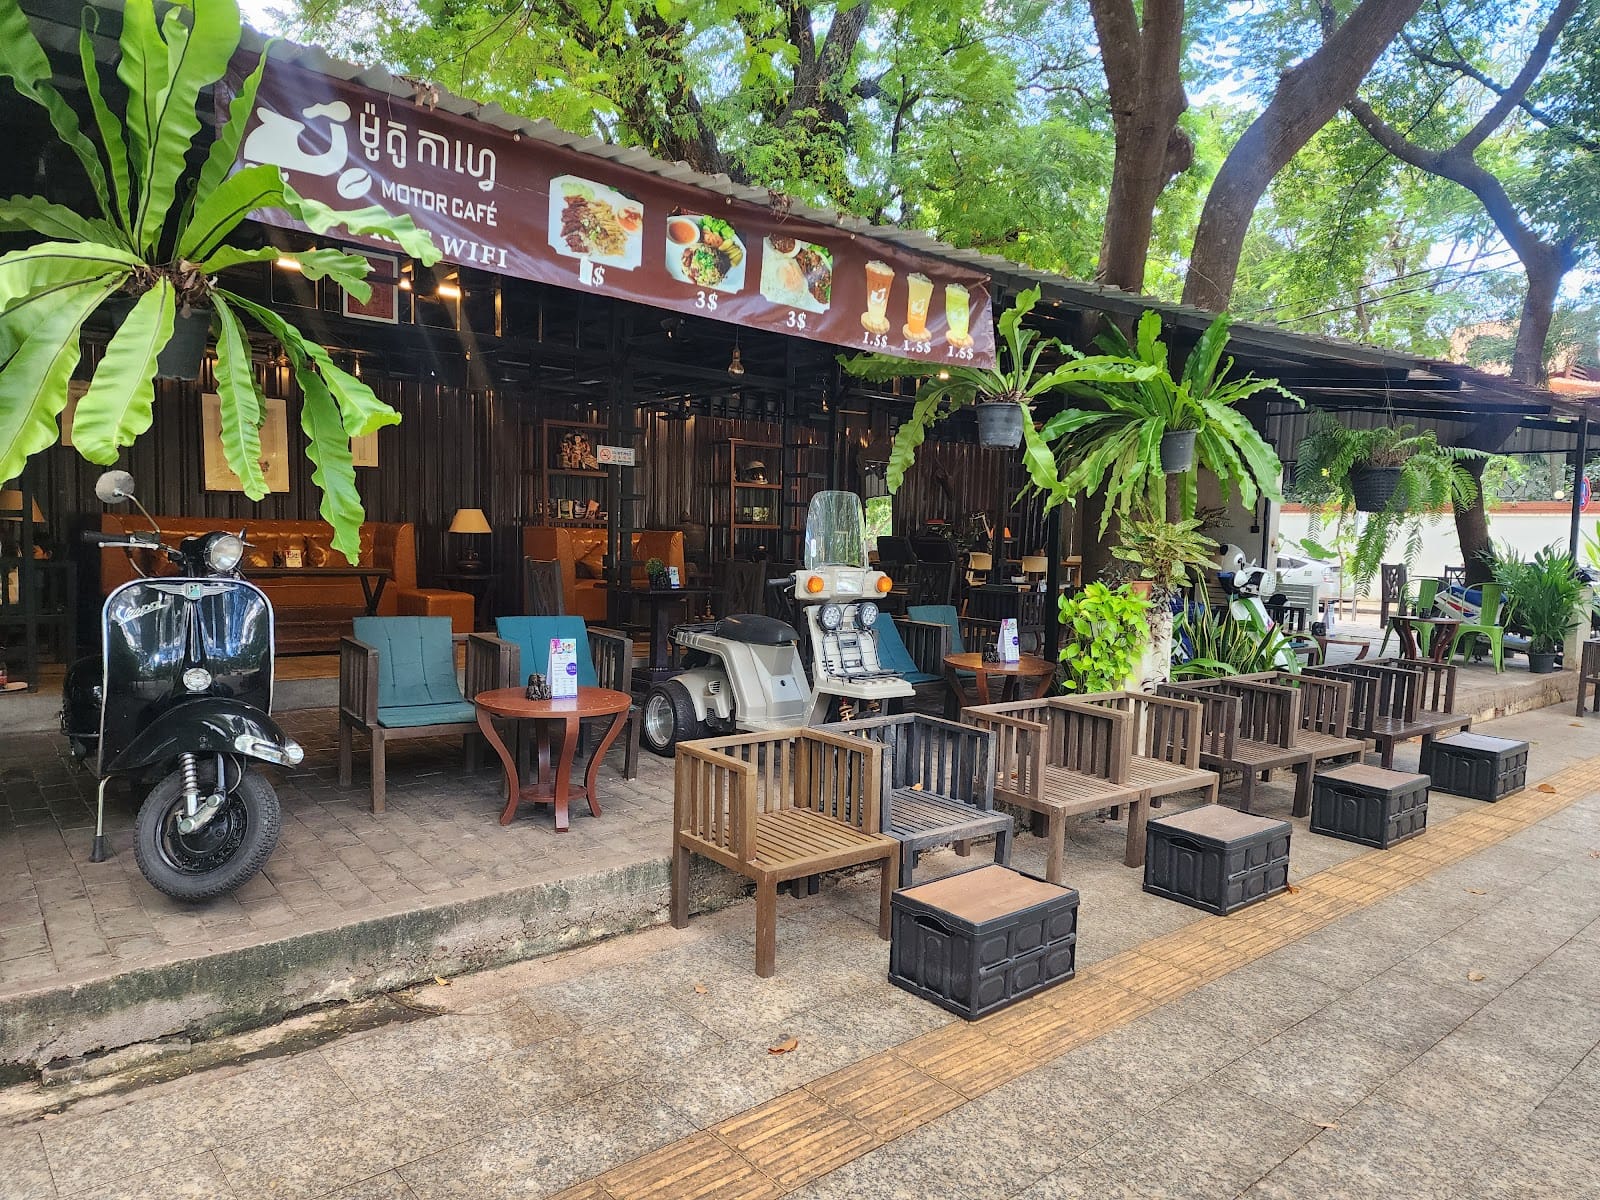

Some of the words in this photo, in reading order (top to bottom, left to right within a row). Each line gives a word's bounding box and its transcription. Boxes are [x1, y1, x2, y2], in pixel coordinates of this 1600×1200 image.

[381, 180, 448, 215] MOTOR
[452, 197, 497, 226] CAFÉ
[440, 234, 508, 268] WIFI
[695, 290, 718, 312] 3$
[786, 311, 807, 329] 3$
[862, 331, 888, 348] 1.5$
[903, 340, 931, 354] 1.5$
